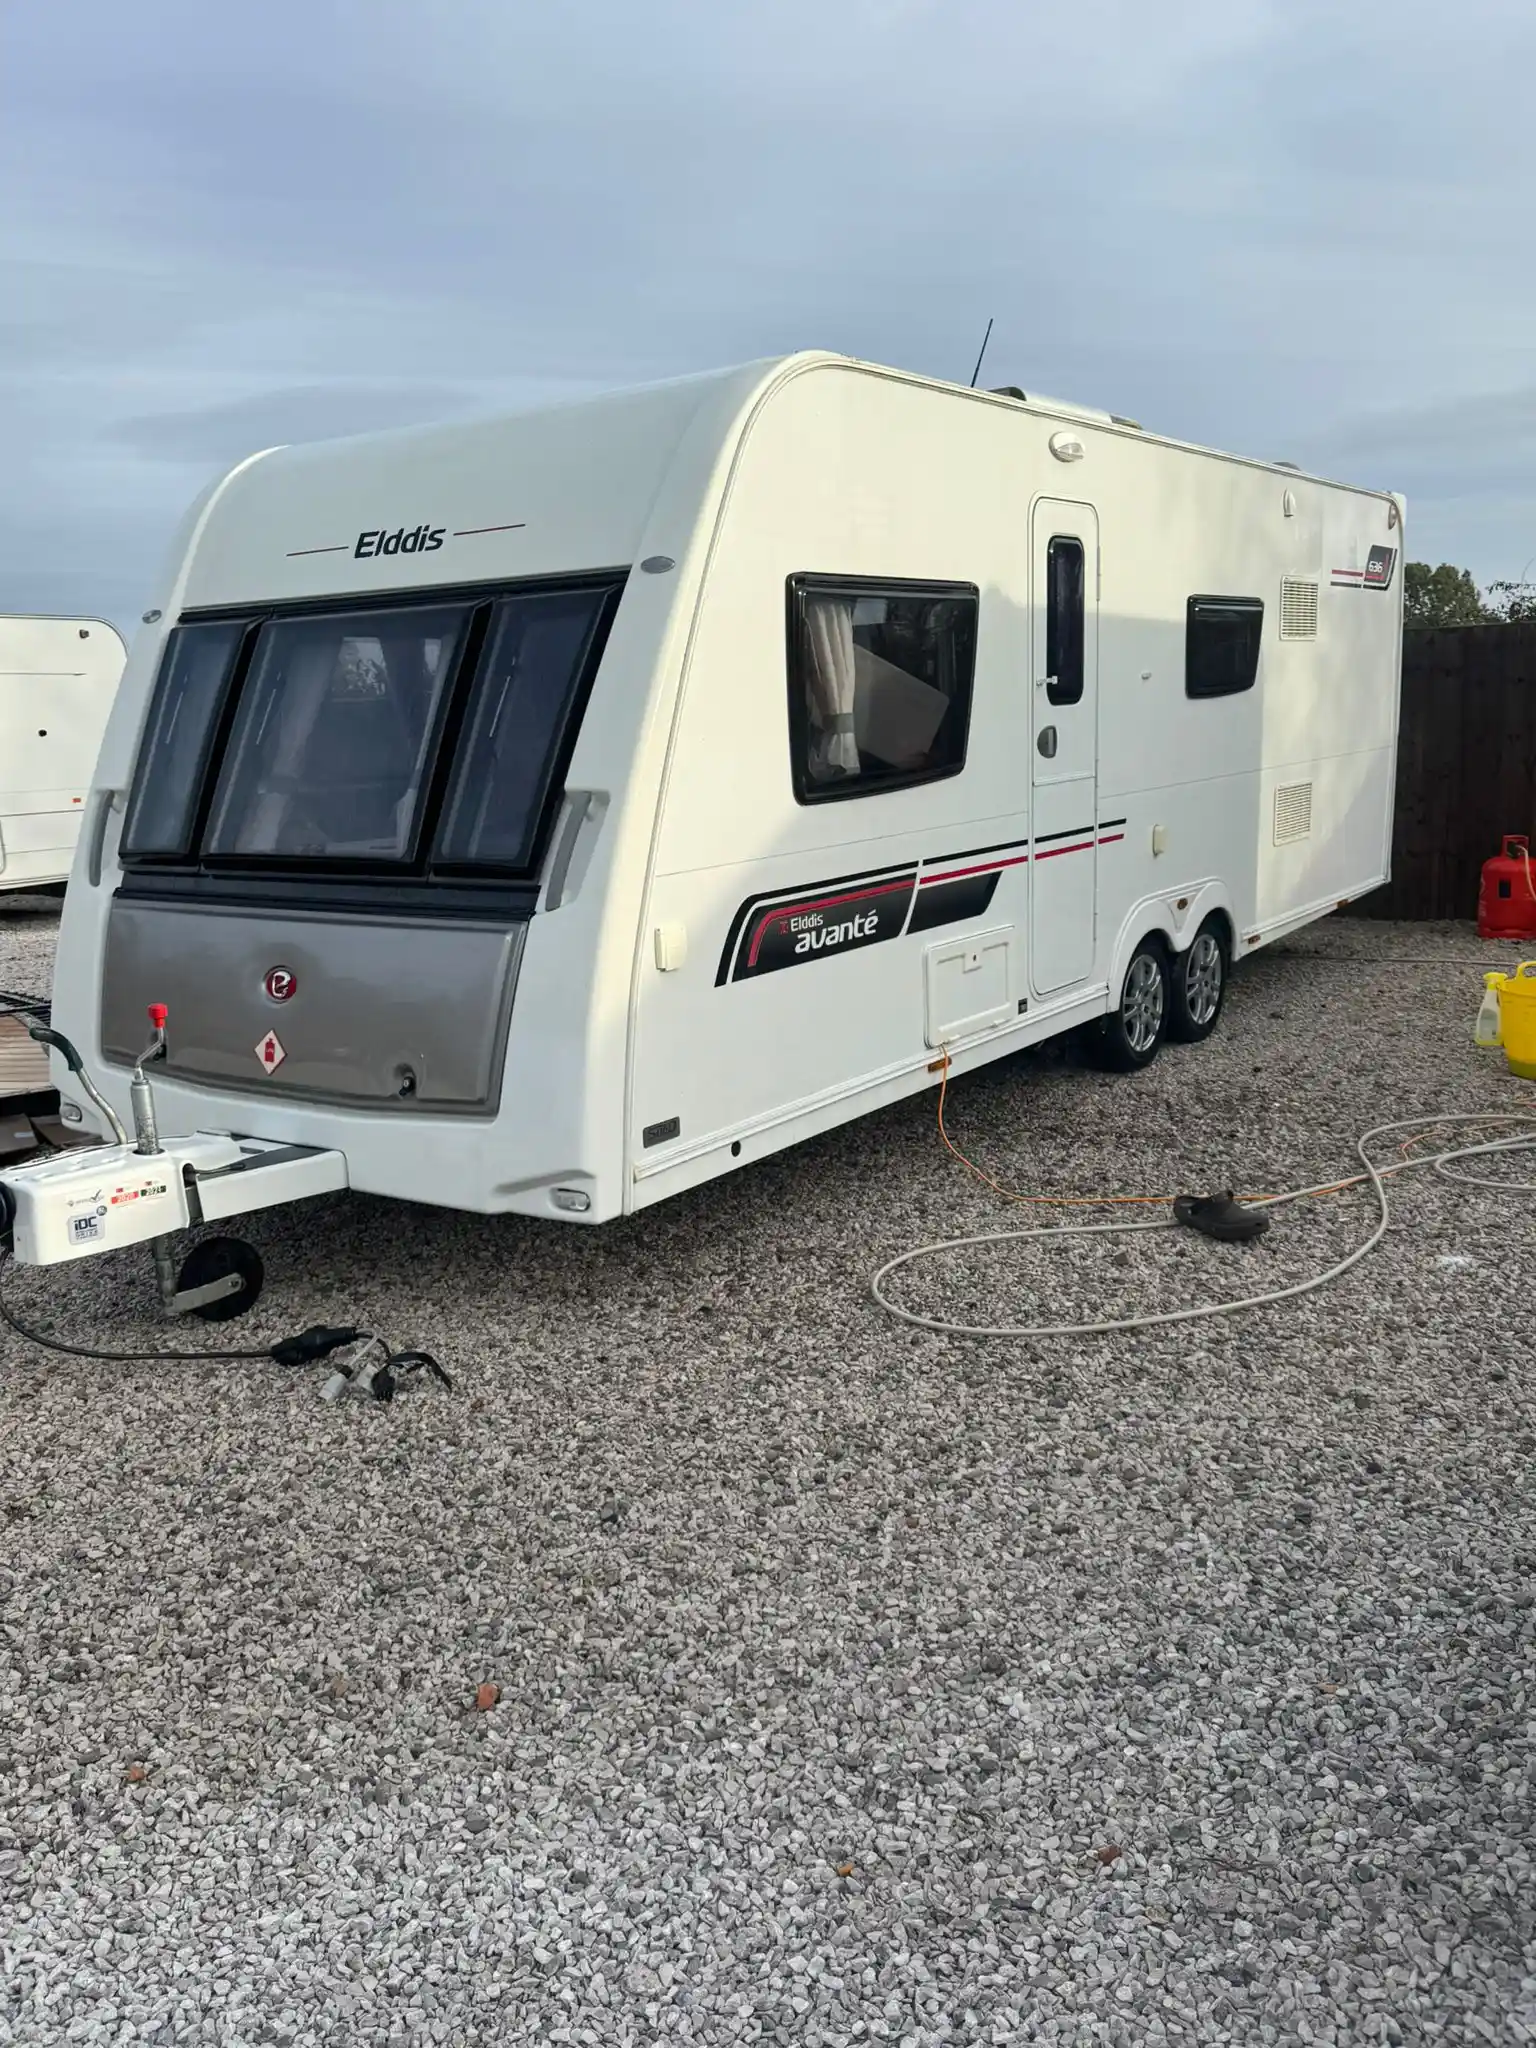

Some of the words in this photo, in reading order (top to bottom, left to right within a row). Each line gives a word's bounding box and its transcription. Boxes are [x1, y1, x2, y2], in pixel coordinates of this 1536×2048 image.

[354, 524, 447, 559] Elddis
[1369, 560, 1384, 573] 636
[790, 913, 824, 933] Elddis
[794, 908, 879, 954] avanté
[73, 1215, 98, 1231] iDC
